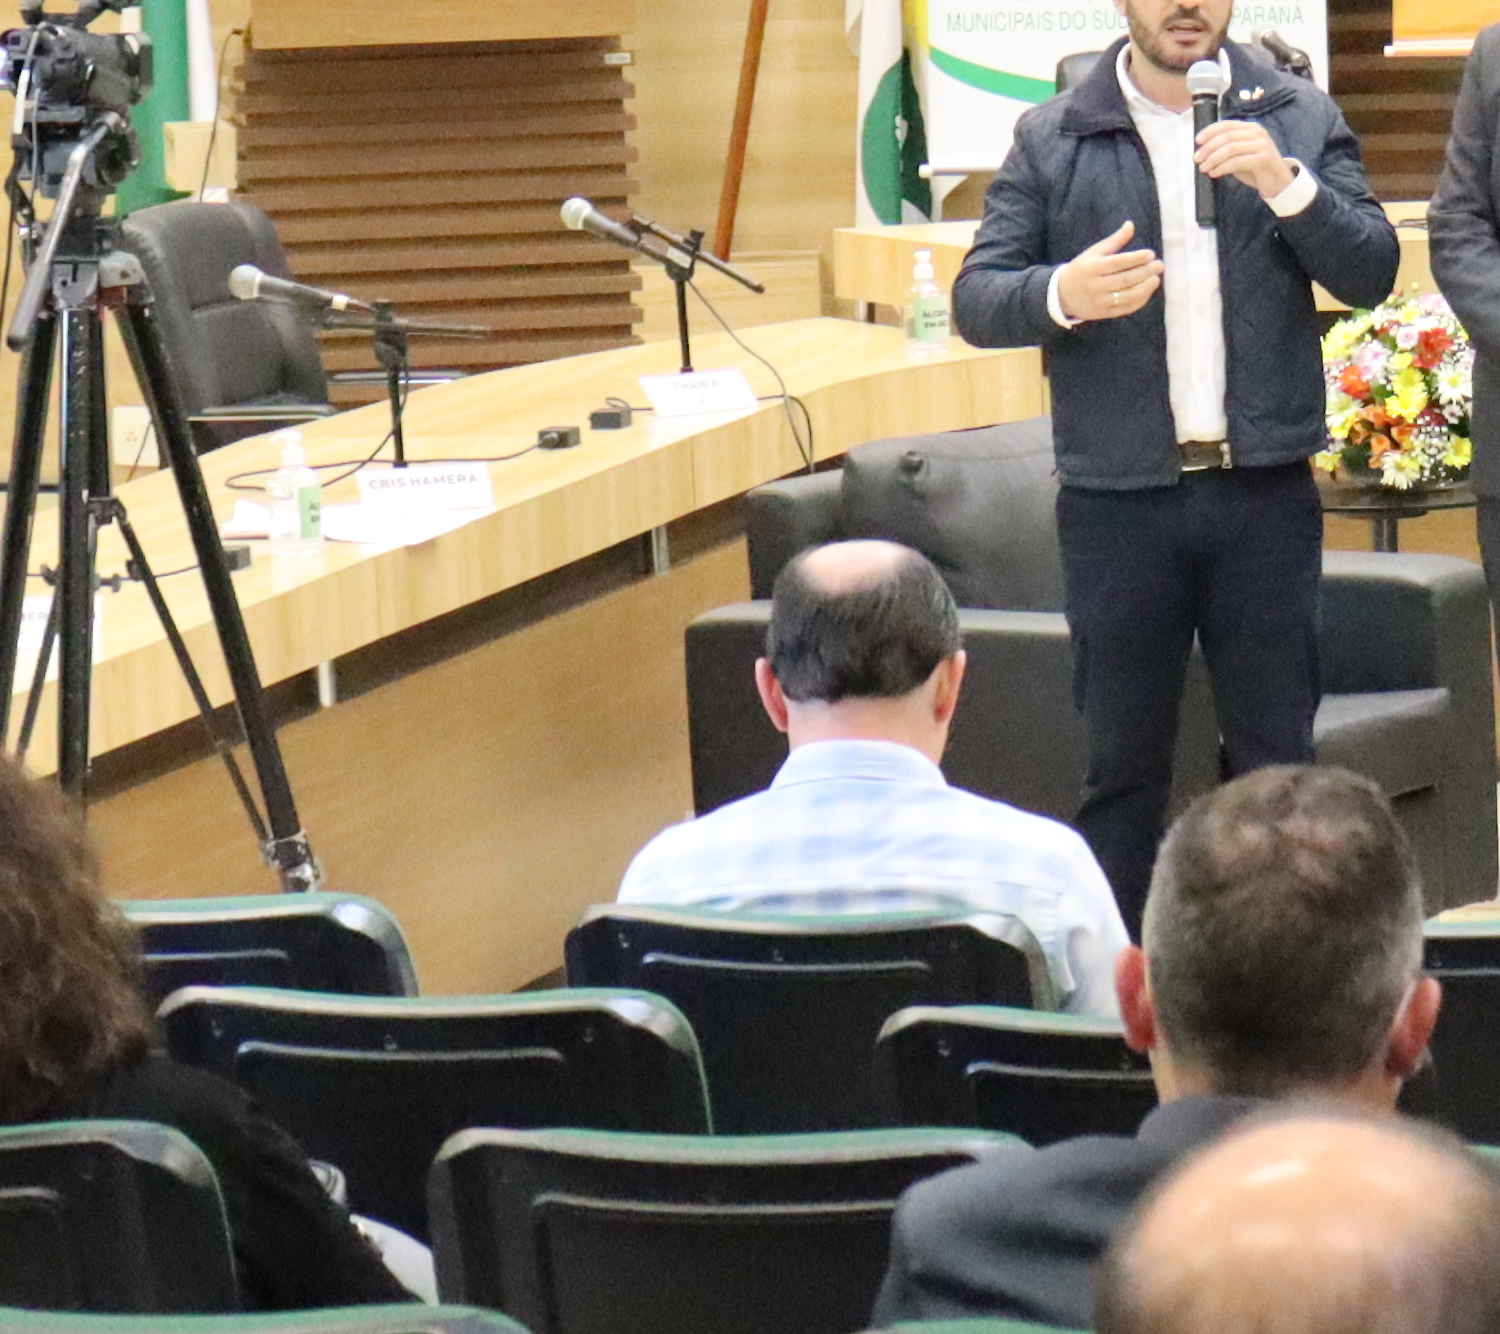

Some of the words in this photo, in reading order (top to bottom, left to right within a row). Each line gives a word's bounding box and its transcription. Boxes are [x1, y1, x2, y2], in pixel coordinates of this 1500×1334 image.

[946, 12, 1054, 33] MUNICIPAIS
[1058, 10, 1089, 31] DO
[369, 478, 406, 490] CRIS
[410, 473, 478, 487] HAMERA
